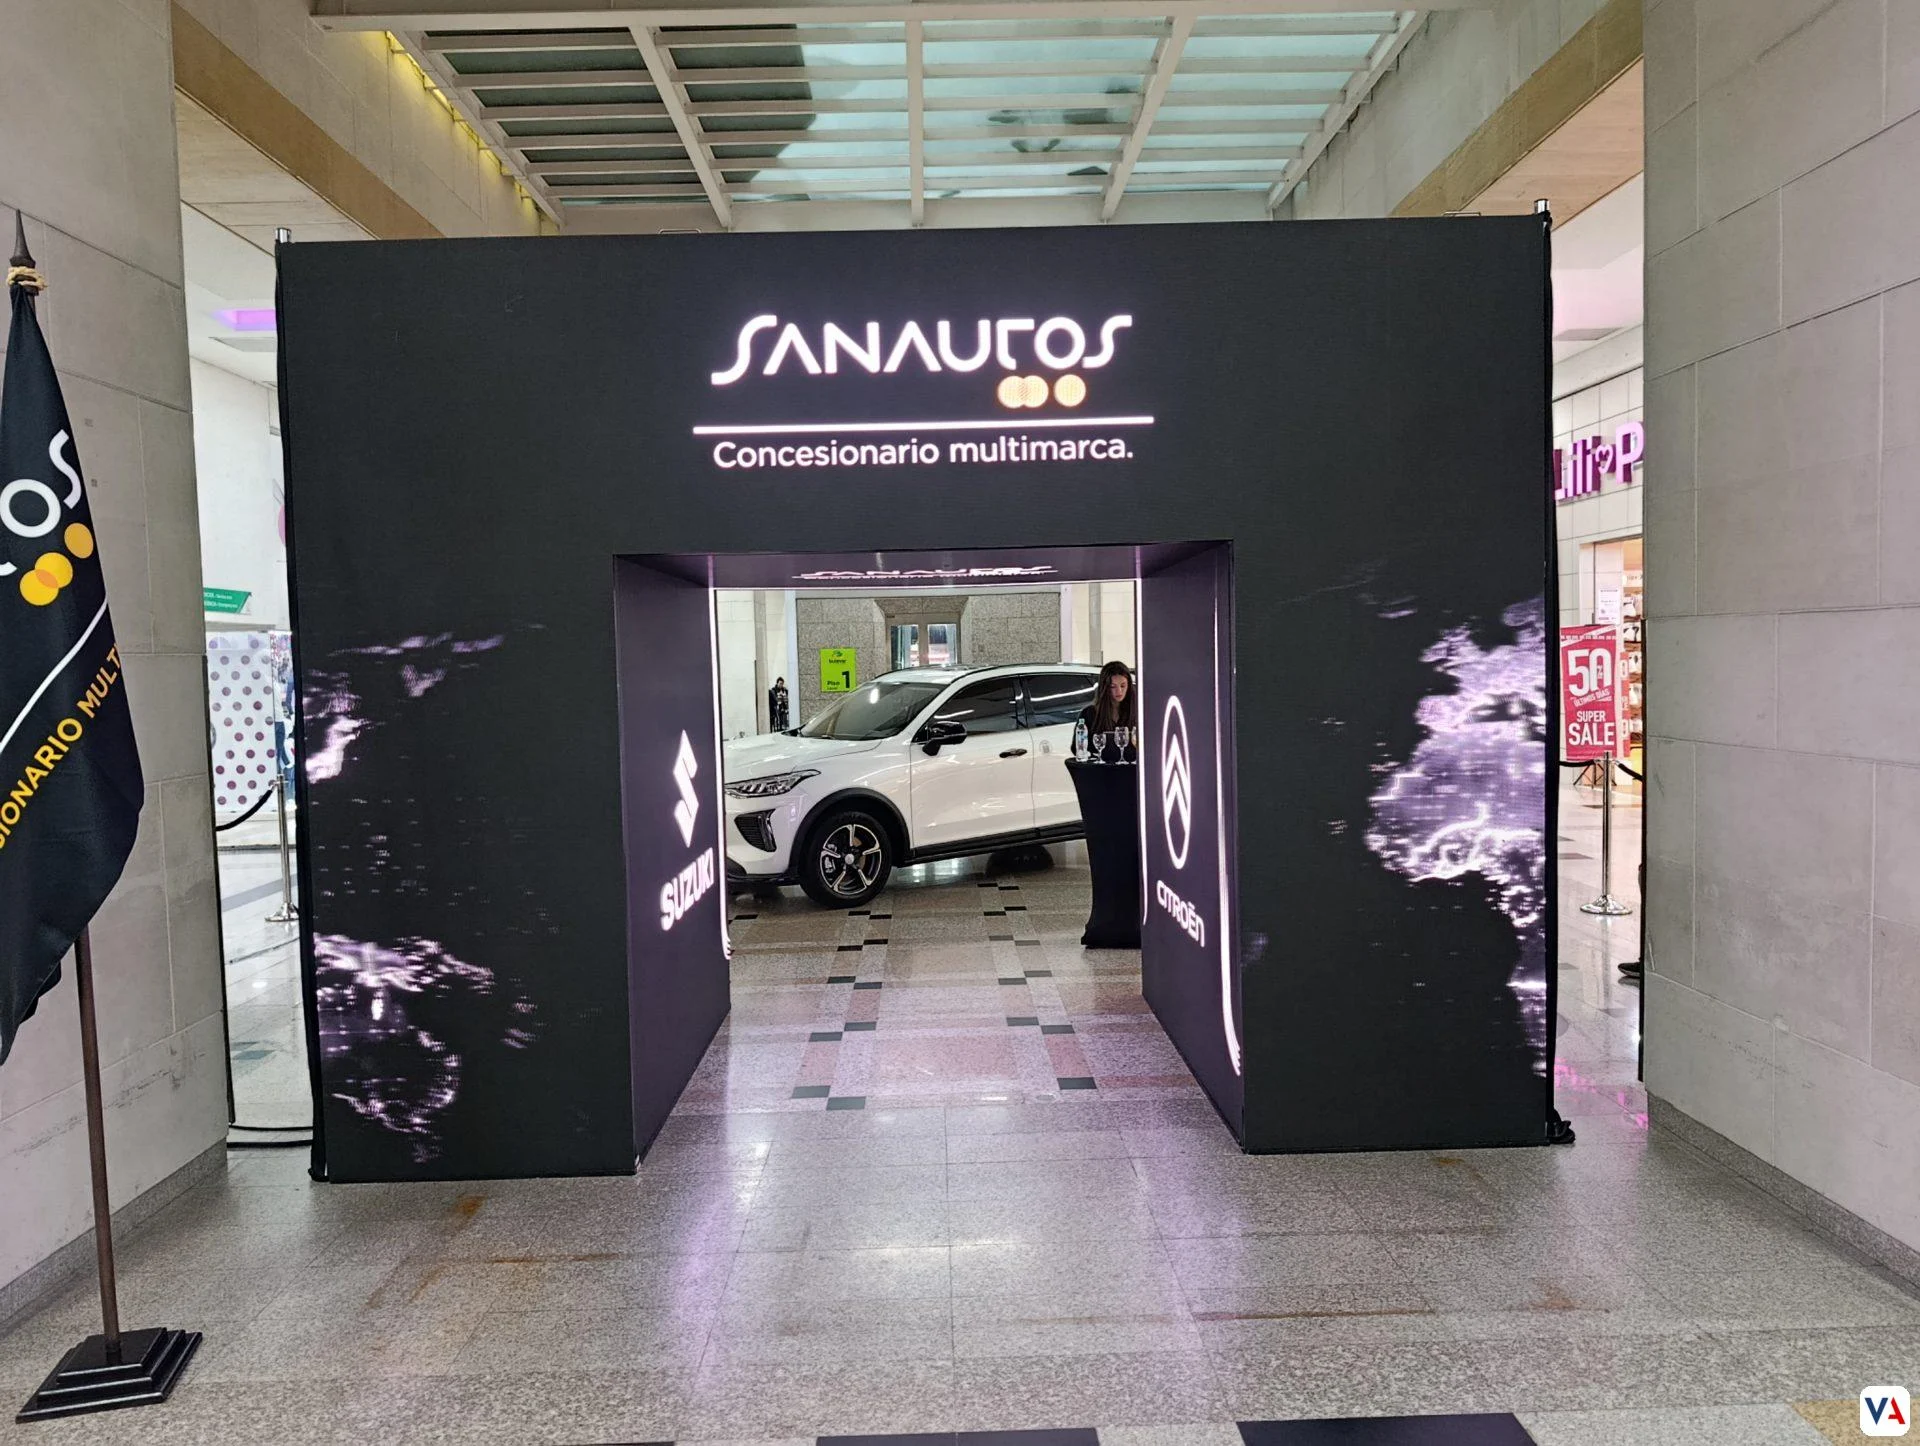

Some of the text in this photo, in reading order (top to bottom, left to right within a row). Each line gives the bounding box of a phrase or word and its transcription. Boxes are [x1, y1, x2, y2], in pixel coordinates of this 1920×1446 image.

[711, 314, 1133, 385] SANAUTOS
[713, 435, 1134, 468] Concesionario multimarca.
[841, 670, 850, 689] 1
[1576, 710, 1606, 722] SUPER
[1568, 722, 1614, 746] SALE
[661, 847, 714, 931] SUZUKI
